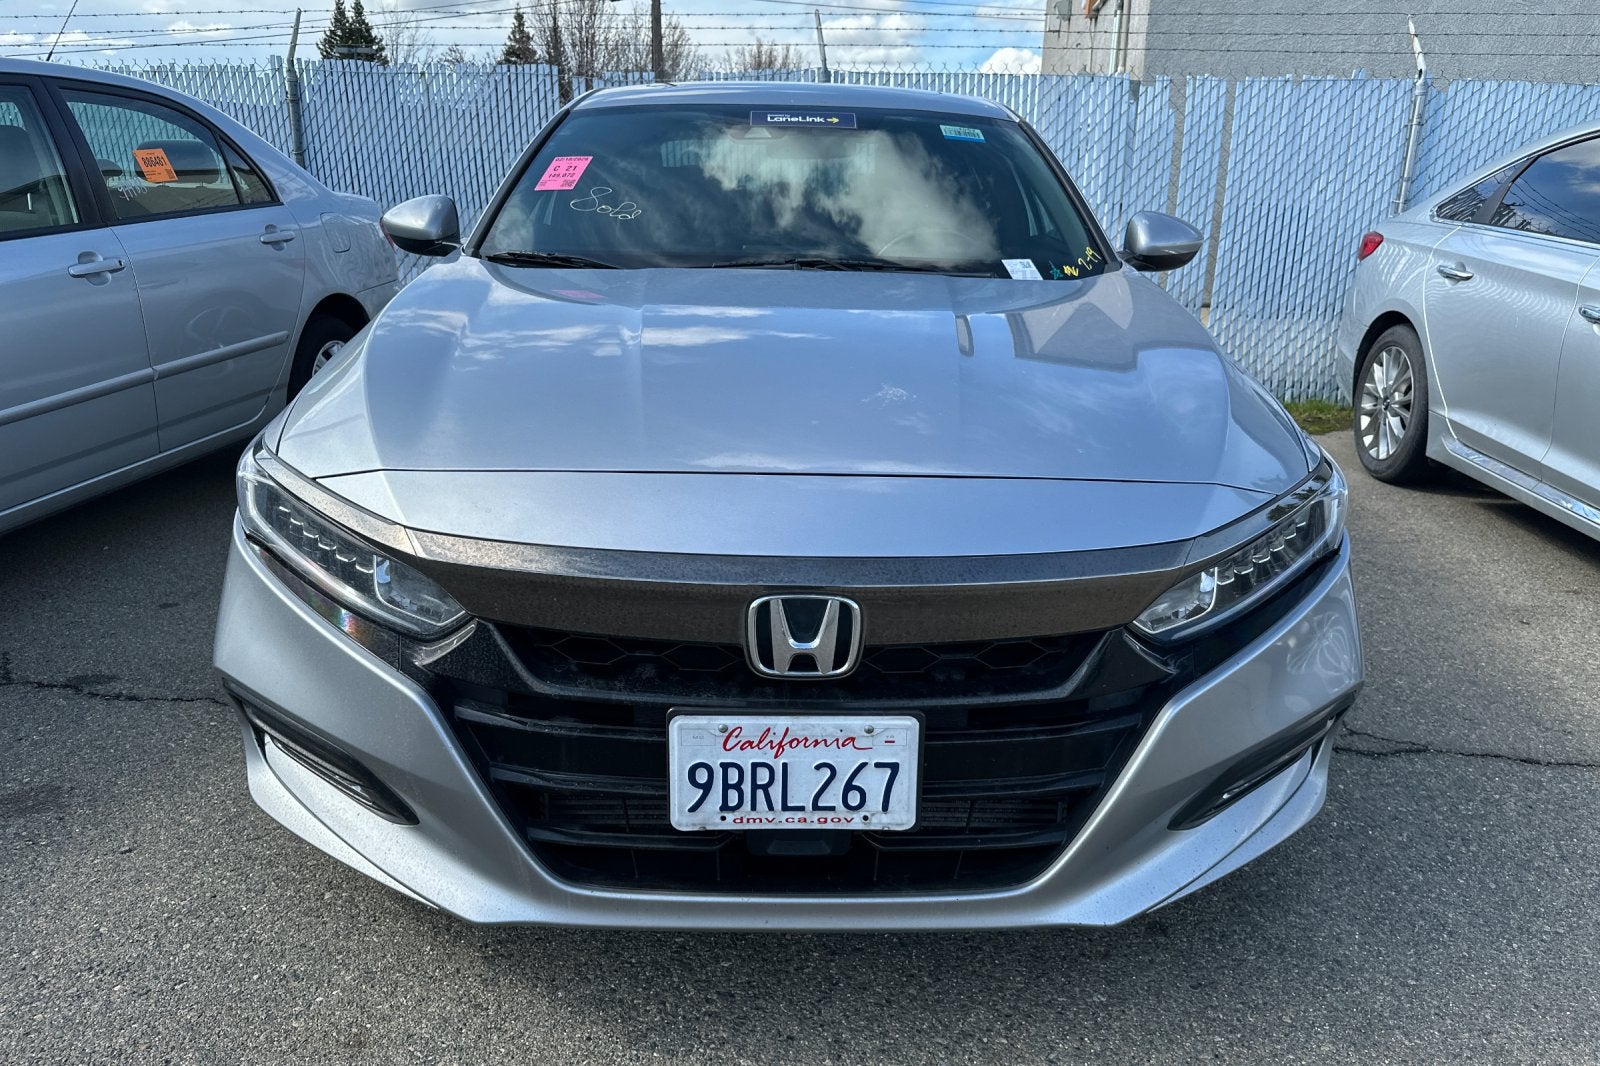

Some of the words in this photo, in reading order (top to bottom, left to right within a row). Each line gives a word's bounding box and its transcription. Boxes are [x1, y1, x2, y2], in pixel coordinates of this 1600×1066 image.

[767, 115, 825, 123] LaneLink
[721, 726, 873, 759] California
[687, 761, 900, 813] 9BRL267
[732, 815, 855, 825] dmv.ca.gov
